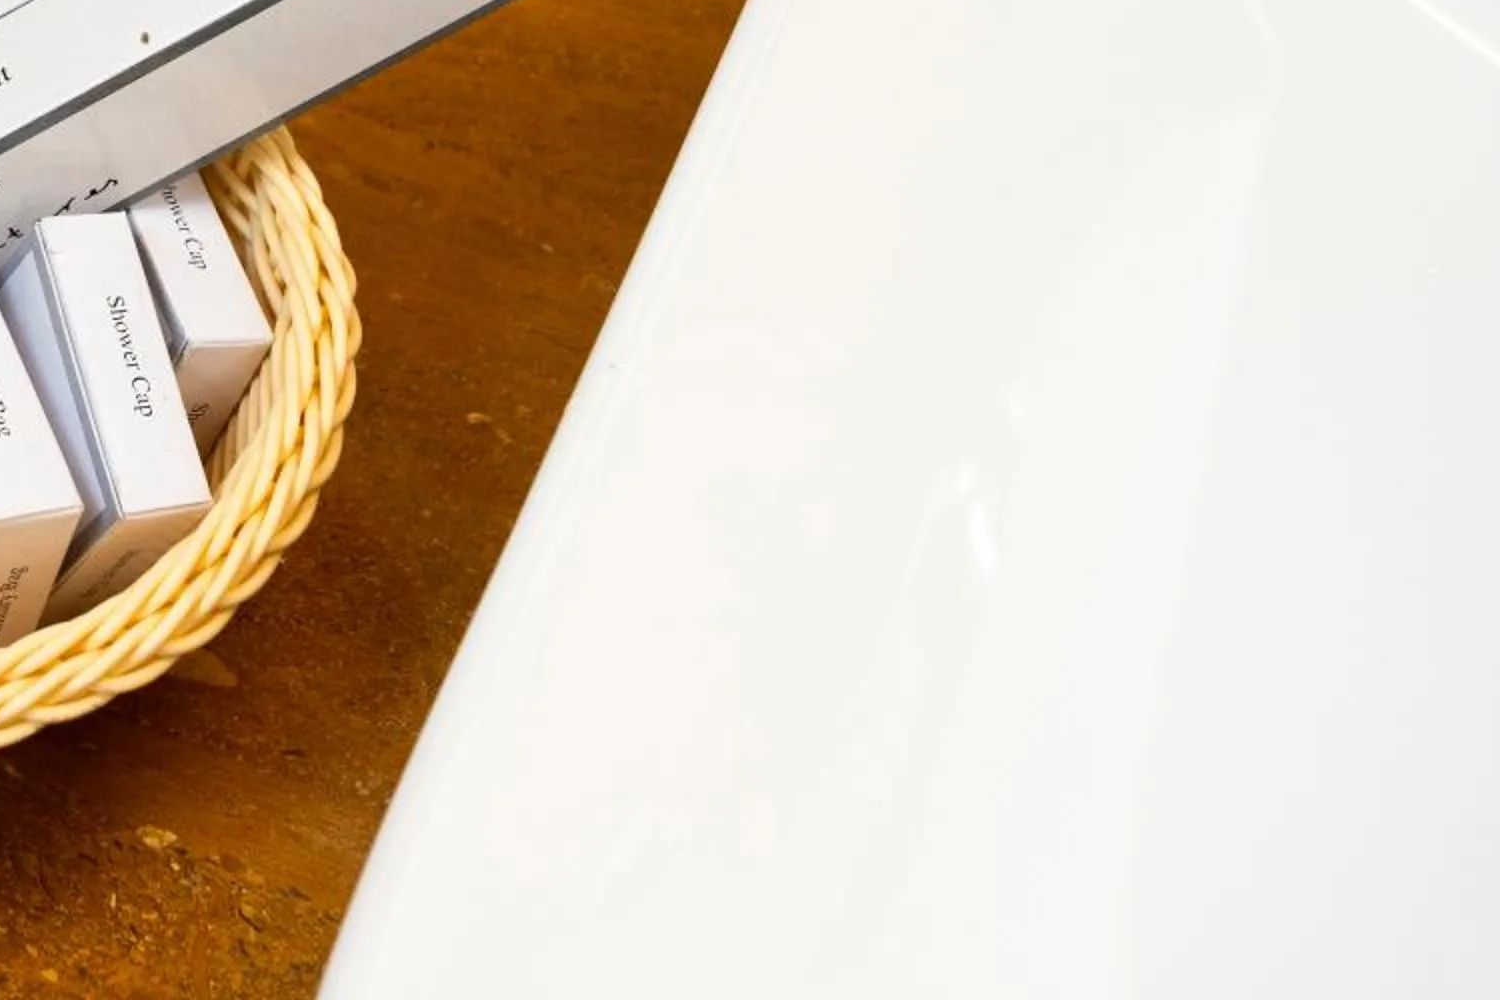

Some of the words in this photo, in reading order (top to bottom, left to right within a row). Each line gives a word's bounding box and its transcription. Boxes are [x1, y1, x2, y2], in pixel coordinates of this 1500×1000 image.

[163, 183, 191, 233] hower
[184, 237, 207, 269] Cap
[106, 295, 141, 372] Shower
[131, 375, 154, 418] Cap
